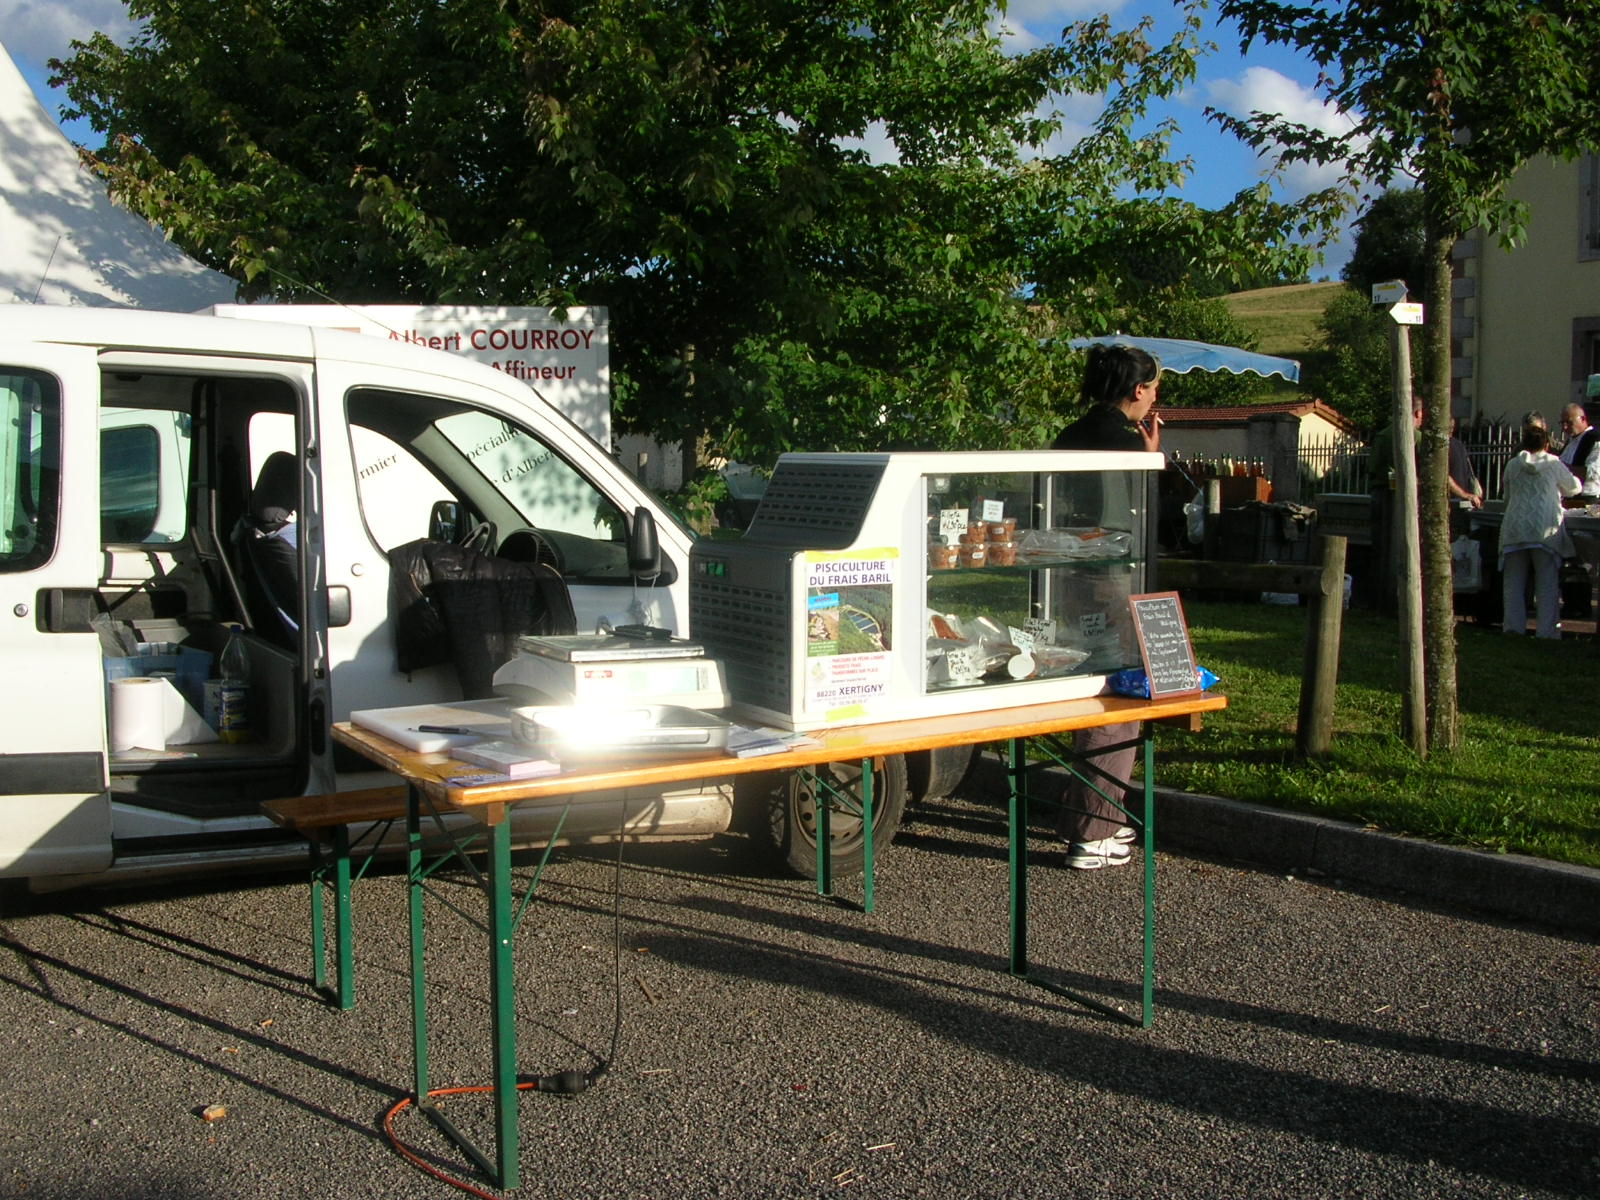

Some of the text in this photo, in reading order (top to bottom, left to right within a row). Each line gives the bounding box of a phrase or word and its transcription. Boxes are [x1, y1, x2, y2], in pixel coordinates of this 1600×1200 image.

[471, 329, 595, 350] COURROY
[360, 454, 396, 479] rmier
[815, 561, 886, 573] PISCICULTURE
[809, 573, 891, 586] DU FRAIS BARIL
[839, 683, 884, 696] XERTIGNY
